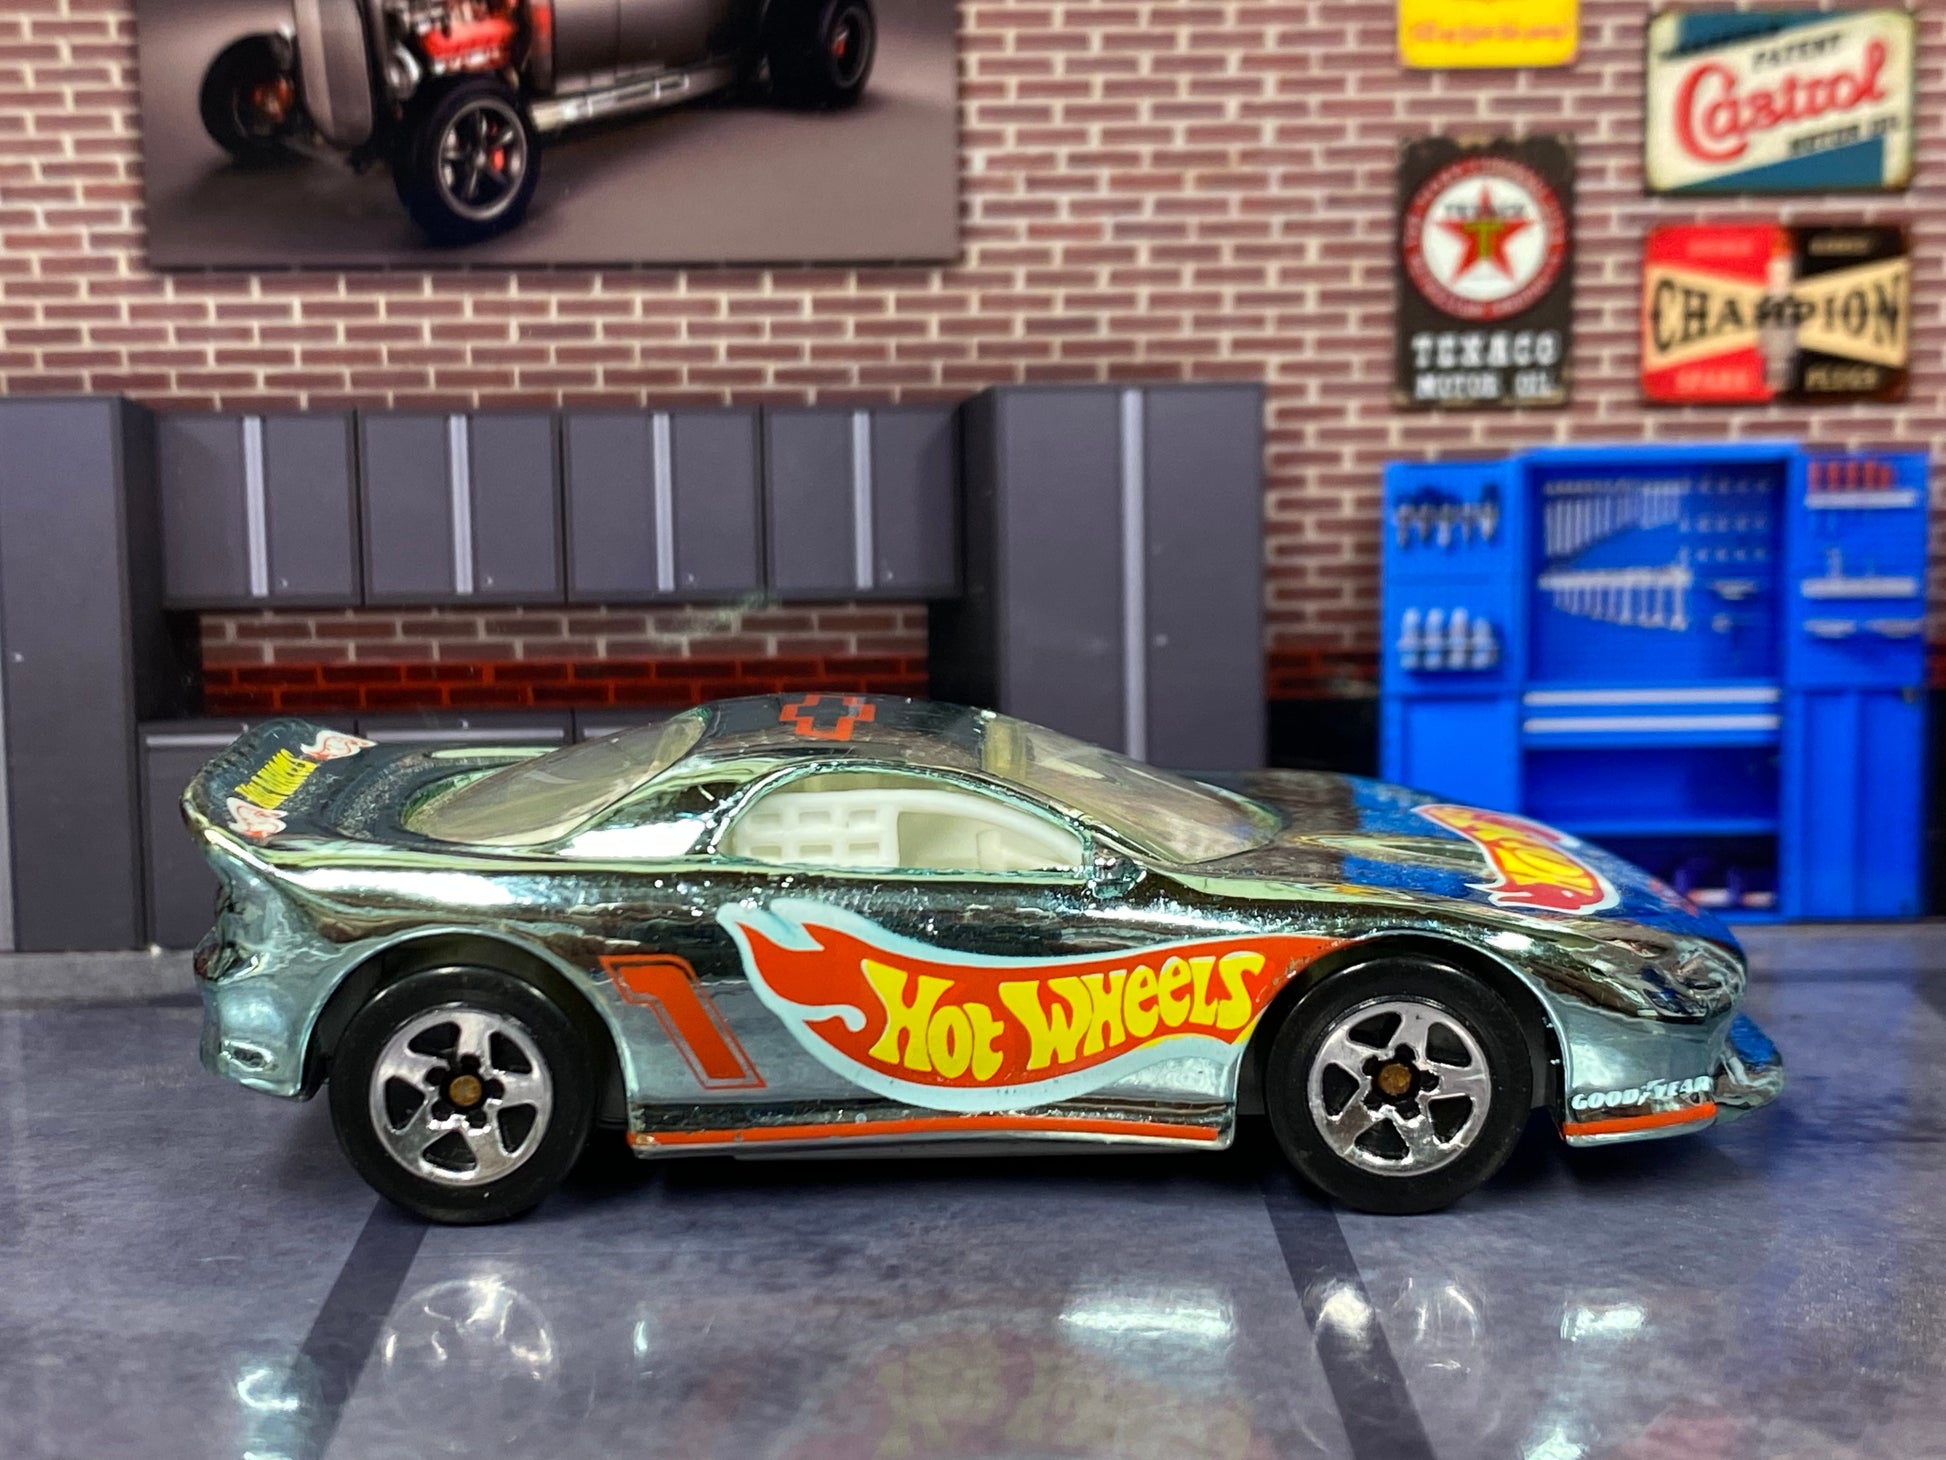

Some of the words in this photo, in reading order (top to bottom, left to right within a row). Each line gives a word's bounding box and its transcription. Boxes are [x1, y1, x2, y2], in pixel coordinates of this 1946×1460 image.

[1752, 34, 1841, 69] PATENT
[1673, 38, 1888, 164] Castrol
[1651, 270, 1902, 352] CHAMPION
[1411, 331, 1561, 368] TEXACO
[1415, 372, 1499, 399] MOTOR
[1571, 1075, 1714, 1110] GOODYEAR
